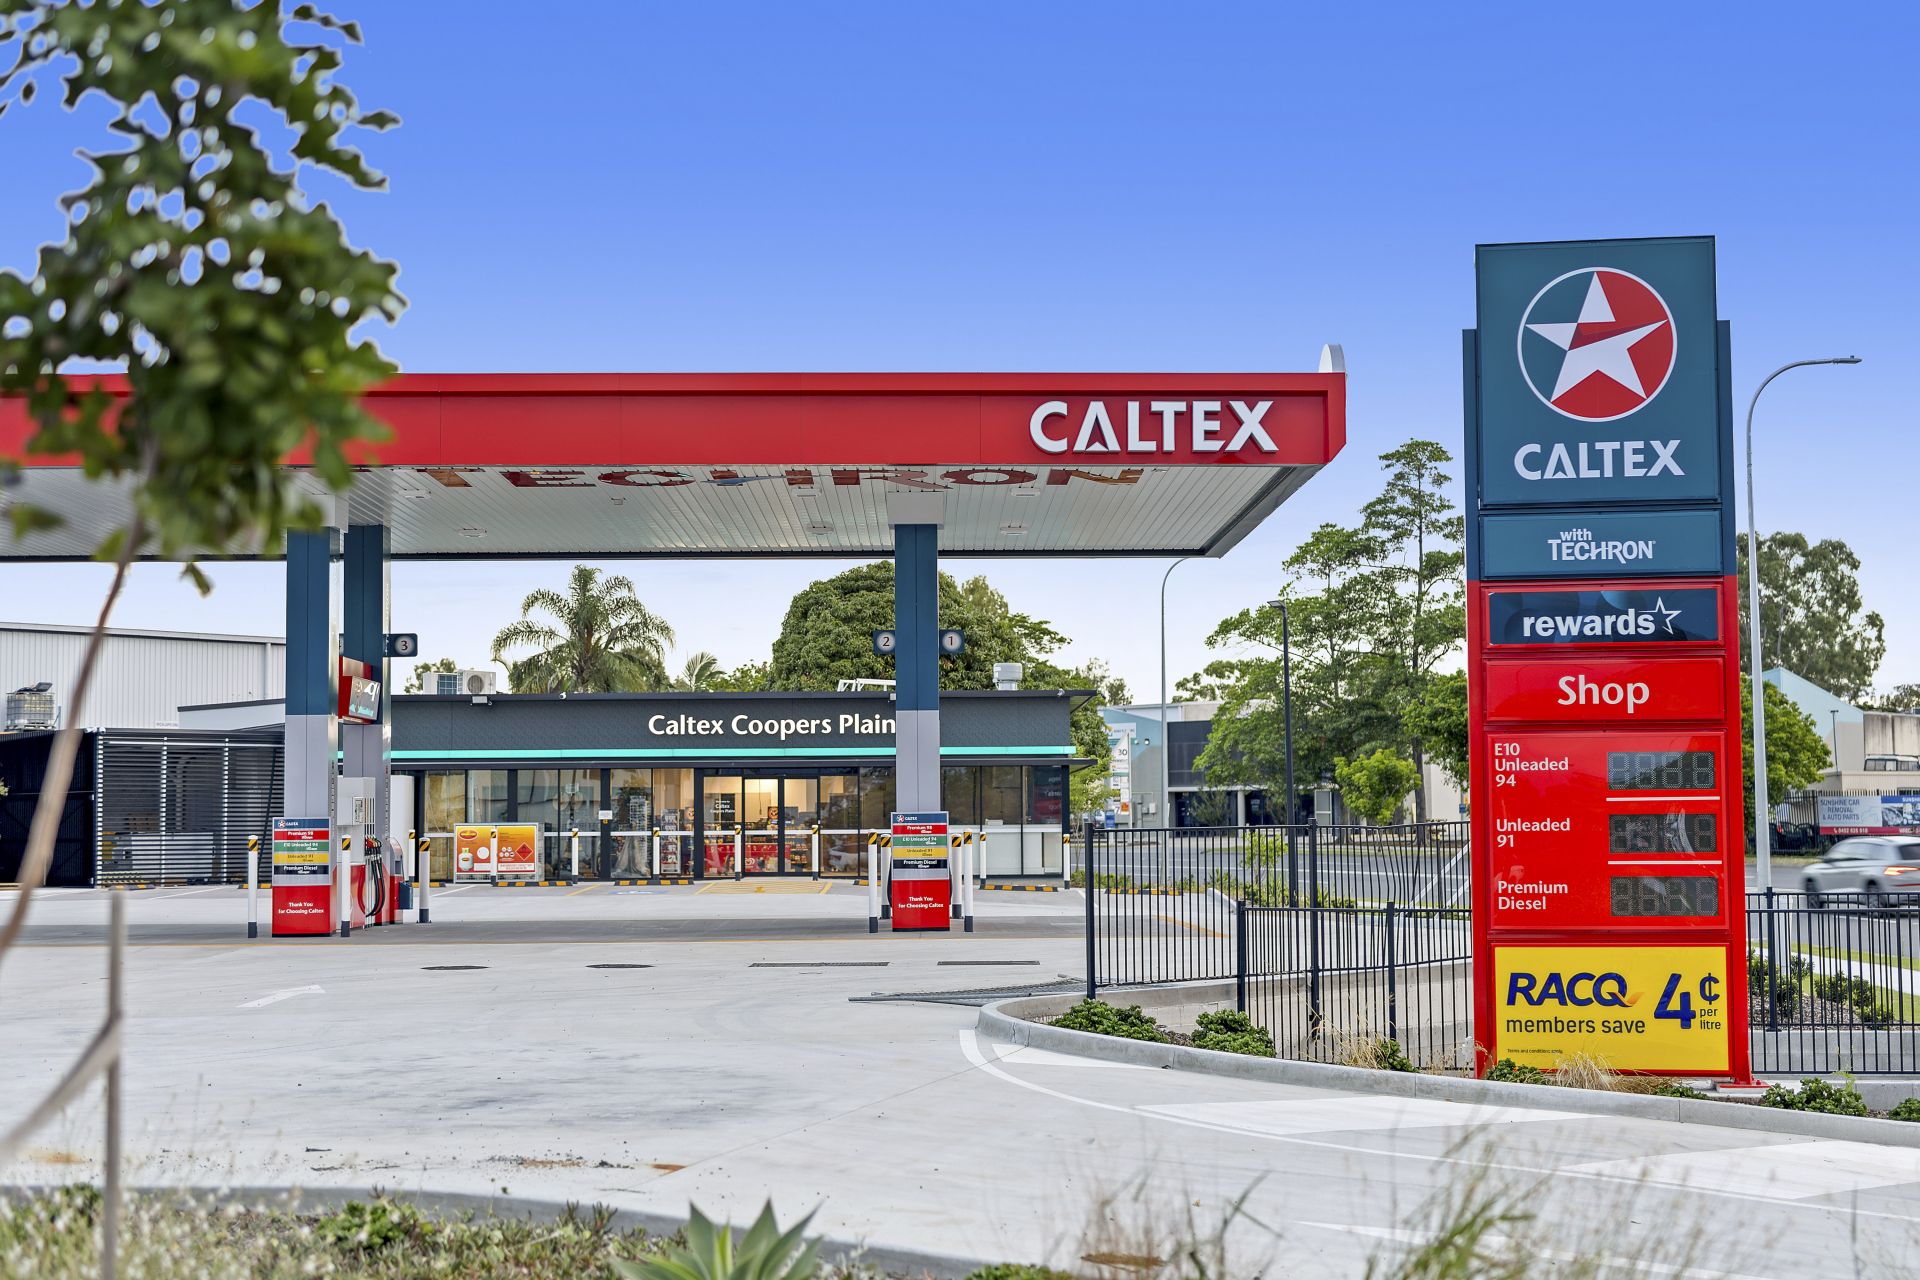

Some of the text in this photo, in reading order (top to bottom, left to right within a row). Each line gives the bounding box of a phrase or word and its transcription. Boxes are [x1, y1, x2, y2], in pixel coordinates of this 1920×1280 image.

[1029, 400, 1279, 453] CALTEX
[1514, 439, 1685, 480] CALTEX
[1560, 528, 1592, 541] with
[1548, 539, 1655, 564] TECHRON
[1523, 608, 1656, 637] rewards
[400, 640, 408, 651] 3
[882, 636, 890, 647] 2
[948, 635, 953, 646] 1
[1558, 675, 1650, 714] Shop
[648, 714, 896, 740] Caltex Coopers Plain
[1494, 743, 1520, 756] E10
[1495, 757, 1569, 772] Unleaded
[1496, 774, 1516, 787] 94
[1496, 818, 1571, 832] Unleaded
[1497, 835, 1515, 848] 91
[1498, 880, 1568, 894] Premium
[1498, 896, 1546, 910] Diesel
[1506, 972, 1631, 1007] RACQ
[1700, 1007, 1718, 1018] per
[1506, 1016, 1646, 1034] members save
[1700, 1020, 1721, 1030] litre
